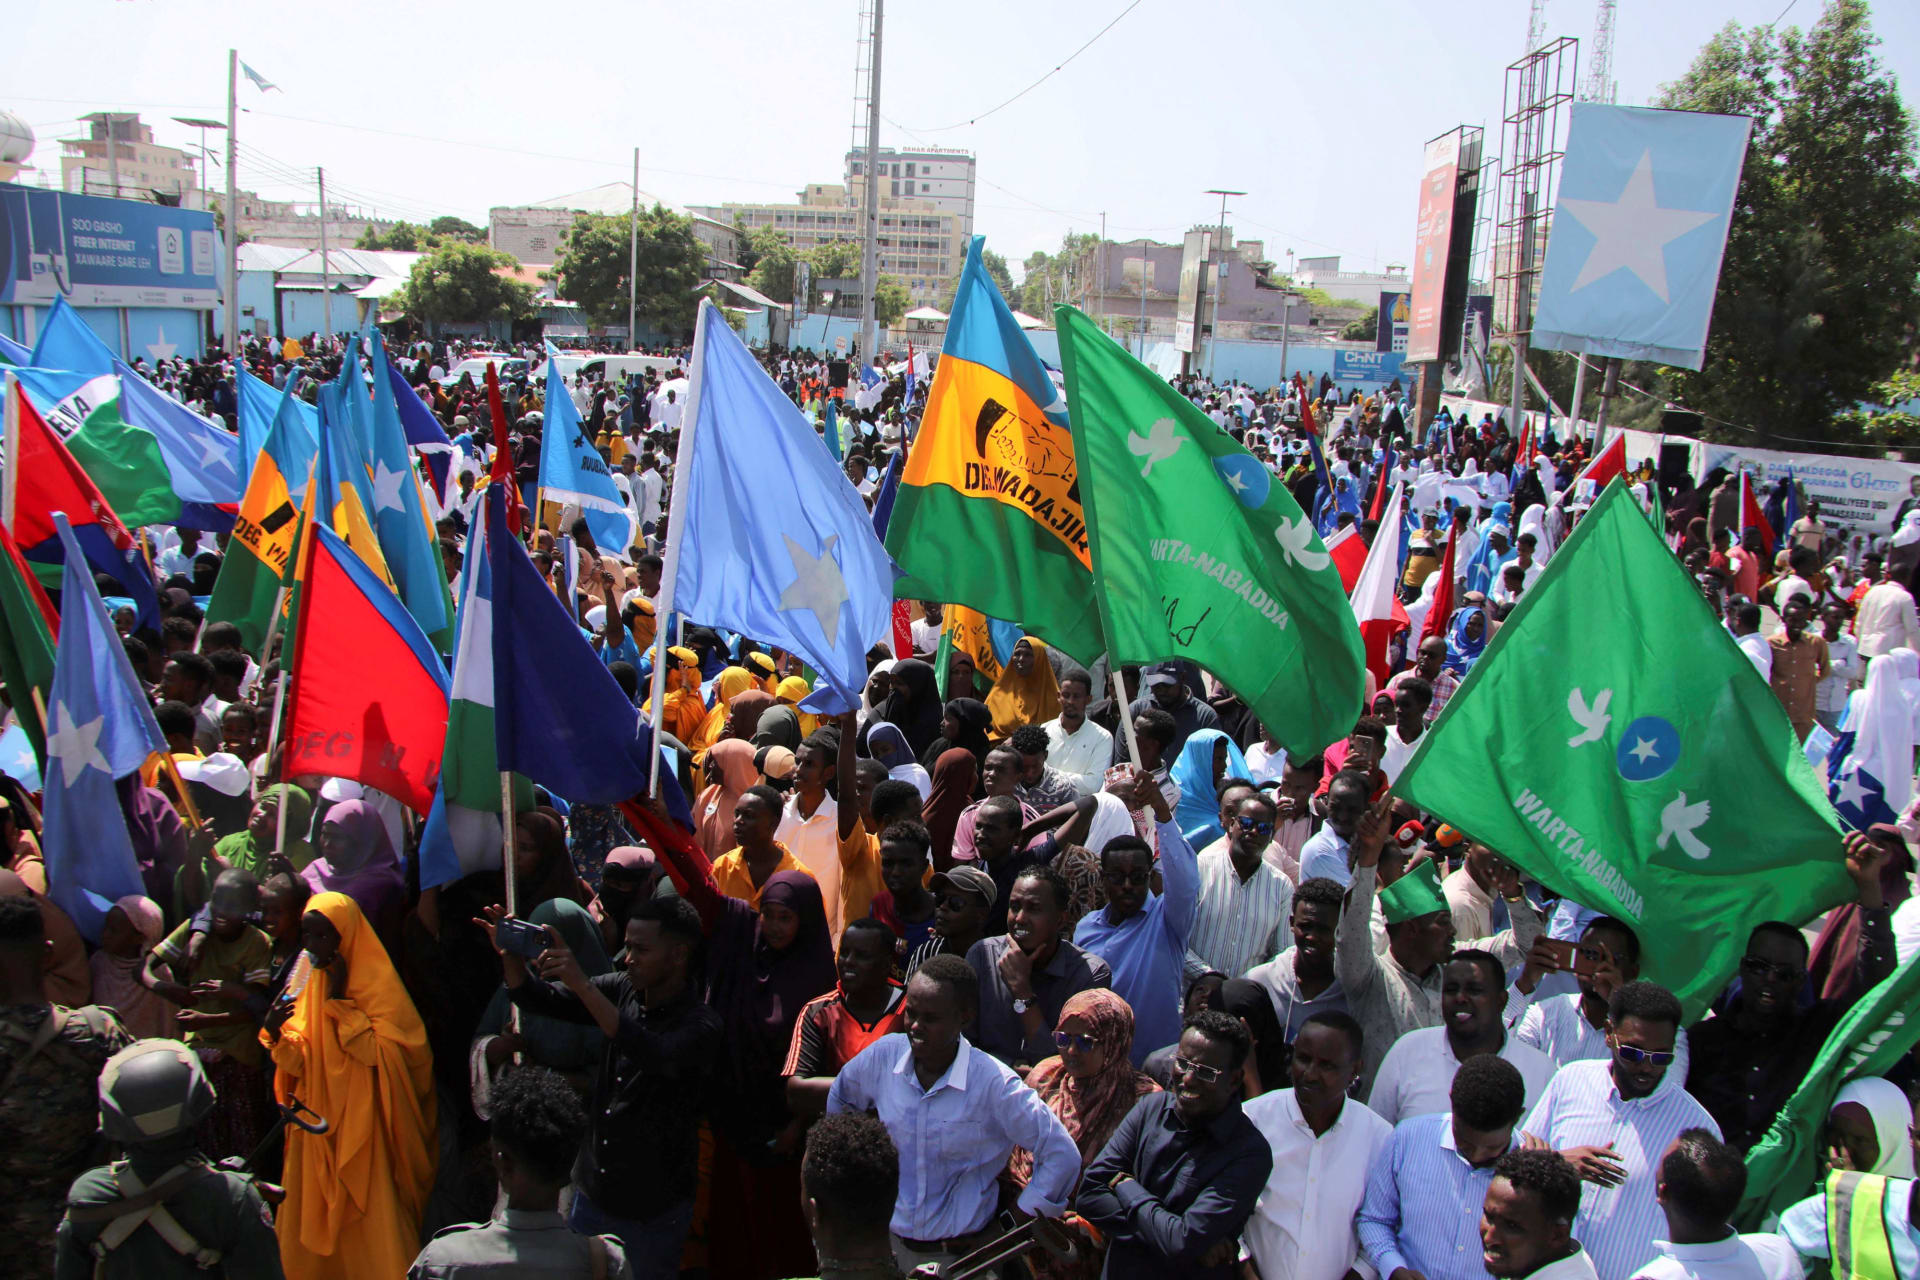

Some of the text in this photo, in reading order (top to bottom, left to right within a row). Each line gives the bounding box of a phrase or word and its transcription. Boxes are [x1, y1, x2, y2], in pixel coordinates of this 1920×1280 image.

[73, 235, 136, 251] FIBER INTERNET
[1150, 538, 1289, 630] ARTA-NABADDA
[1513, 787, 1644, 919] WARTA-NABADDA
